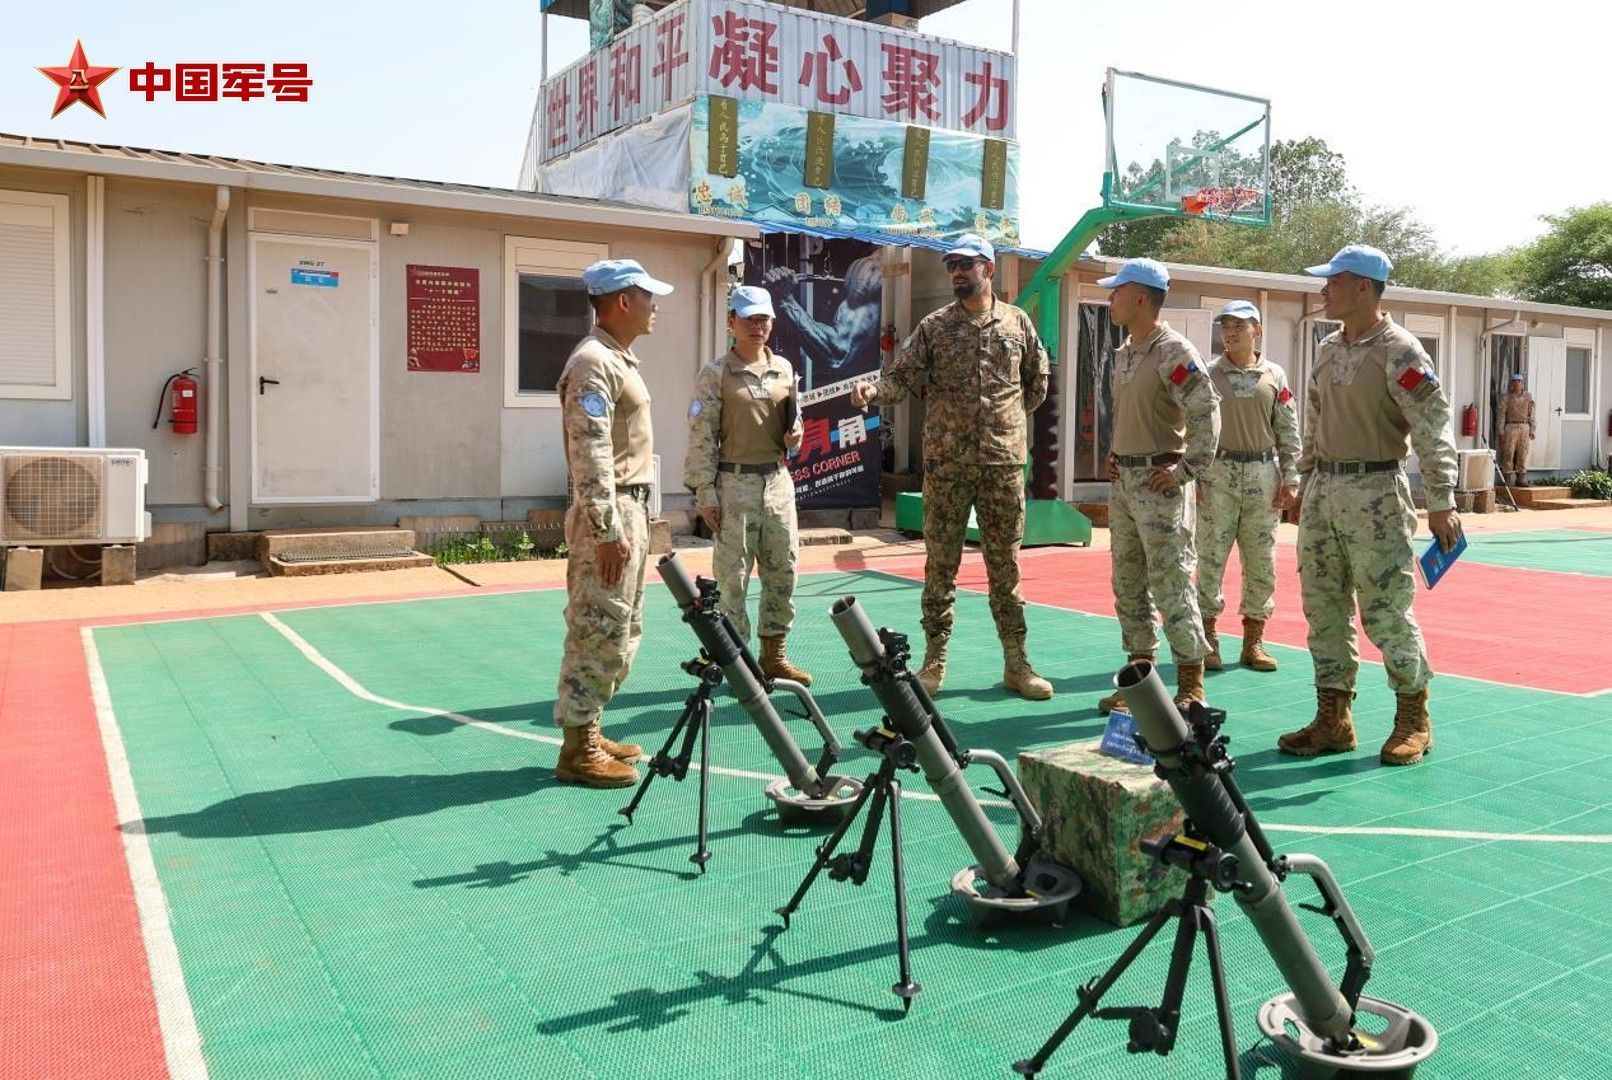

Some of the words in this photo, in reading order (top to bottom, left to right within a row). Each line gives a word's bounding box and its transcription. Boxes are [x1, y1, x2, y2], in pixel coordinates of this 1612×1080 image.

[547, 12, 690, 149] 世界和平
[708, 9, 1010, 132] 凝心聚力
[784, 414, 867, 465] 身角
[812, 450, 861, 475] CORNER
